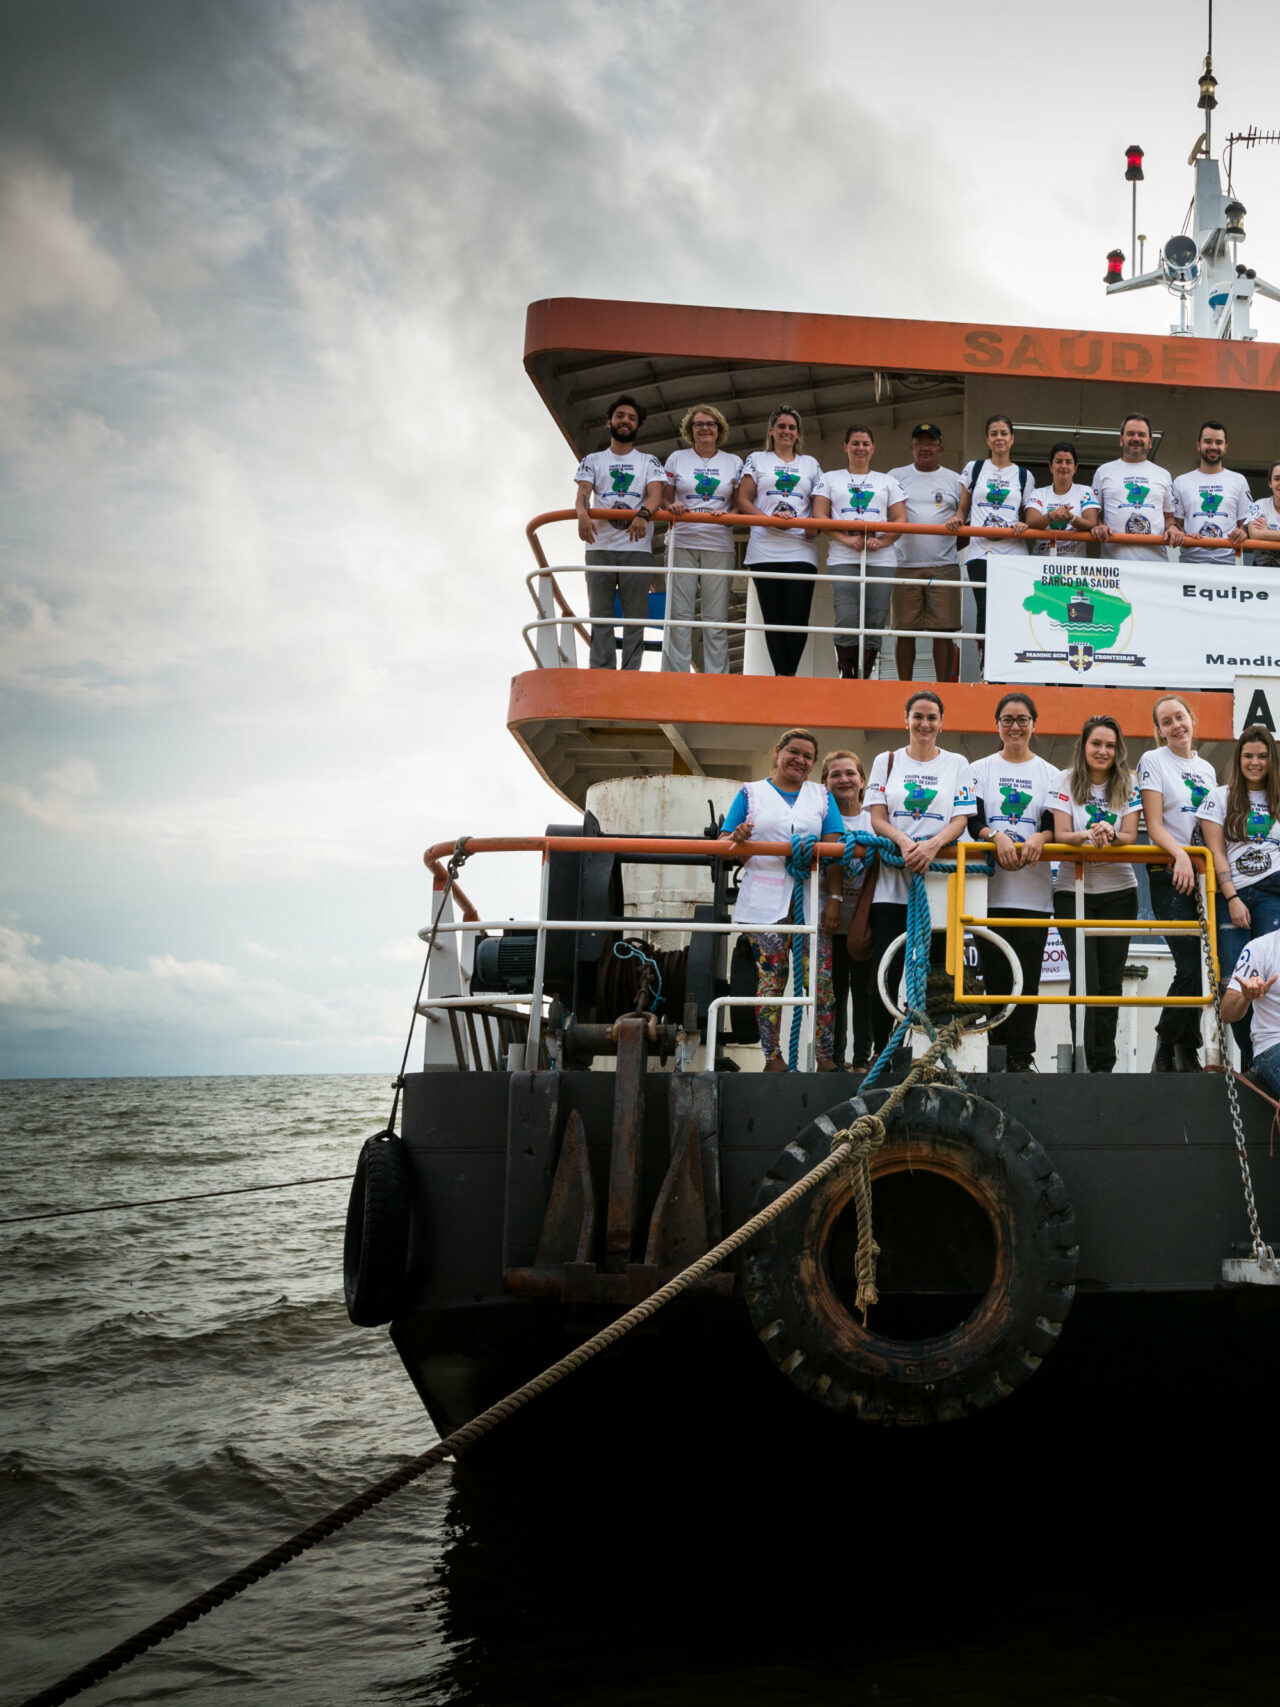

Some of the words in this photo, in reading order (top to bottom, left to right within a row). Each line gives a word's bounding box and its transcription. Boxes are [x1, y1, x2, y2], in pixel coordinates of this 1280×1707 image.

[962, 331, 1200, 380] SAÚDE
[1042, 564, 1078, 576] EQUIPE
[1080, 566, 1120, 578] MANDIC
[1041, 576, 1074, 587] BARCO
[1076, 577, 1089, 588] DA
[1182, 584, 1270, 603] Equipe
